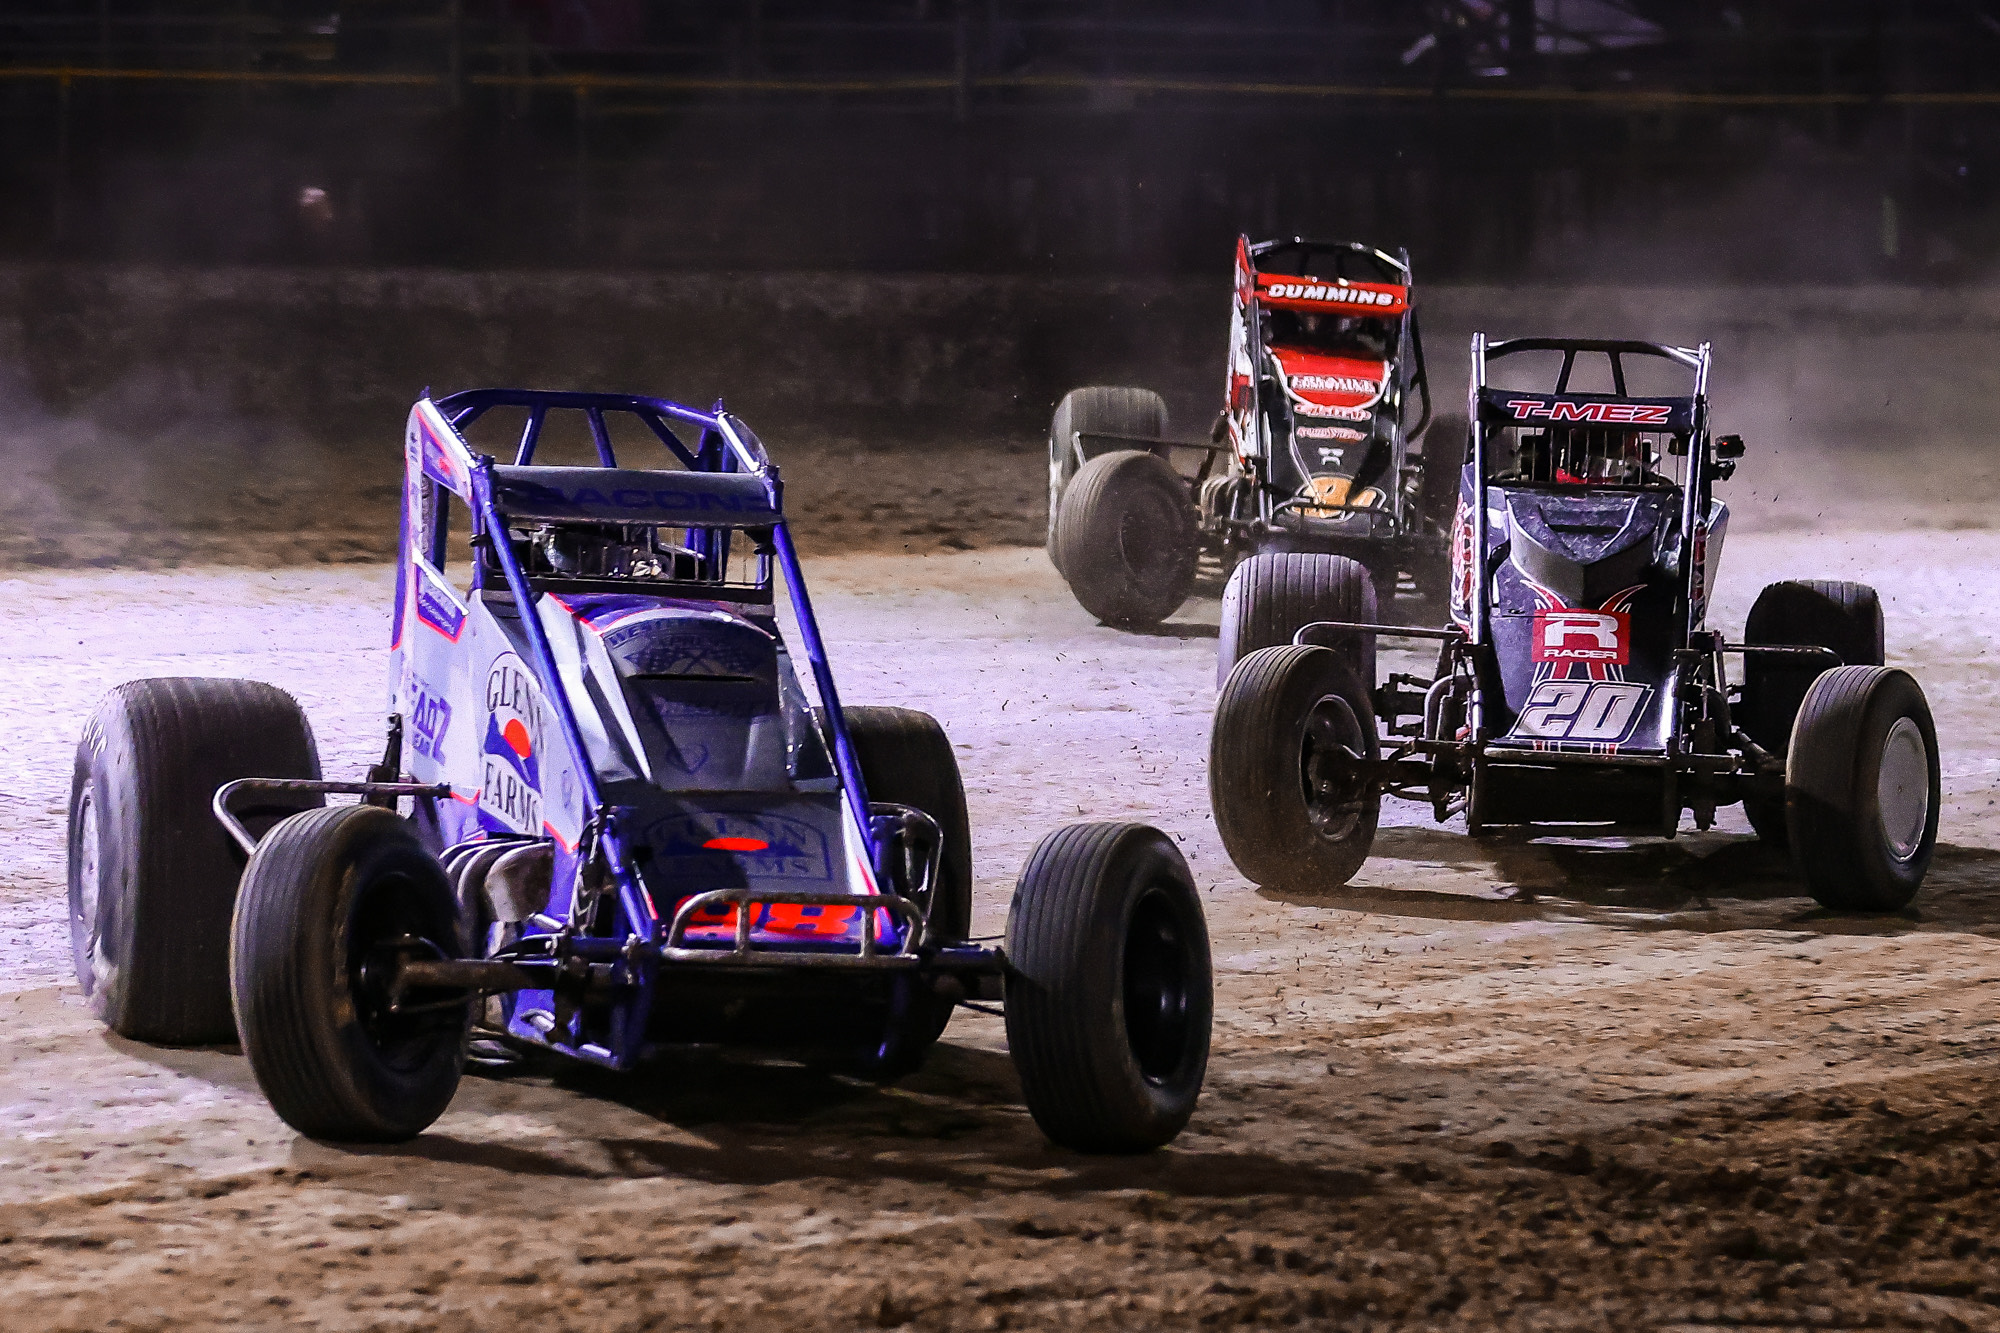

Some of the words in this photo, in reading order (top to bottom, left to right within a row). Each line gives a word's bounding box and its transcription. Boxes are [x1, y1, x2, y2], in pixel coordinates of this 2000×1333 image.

[1268, 283, 1394, 306] CUMMINS
[1507, 399, 1672, 424] T-MEZ
[1543, 648, 1618, 660] RACER
[1508, 682, 1653, 744] 20
[483, 761, 539, 834] FARMS
